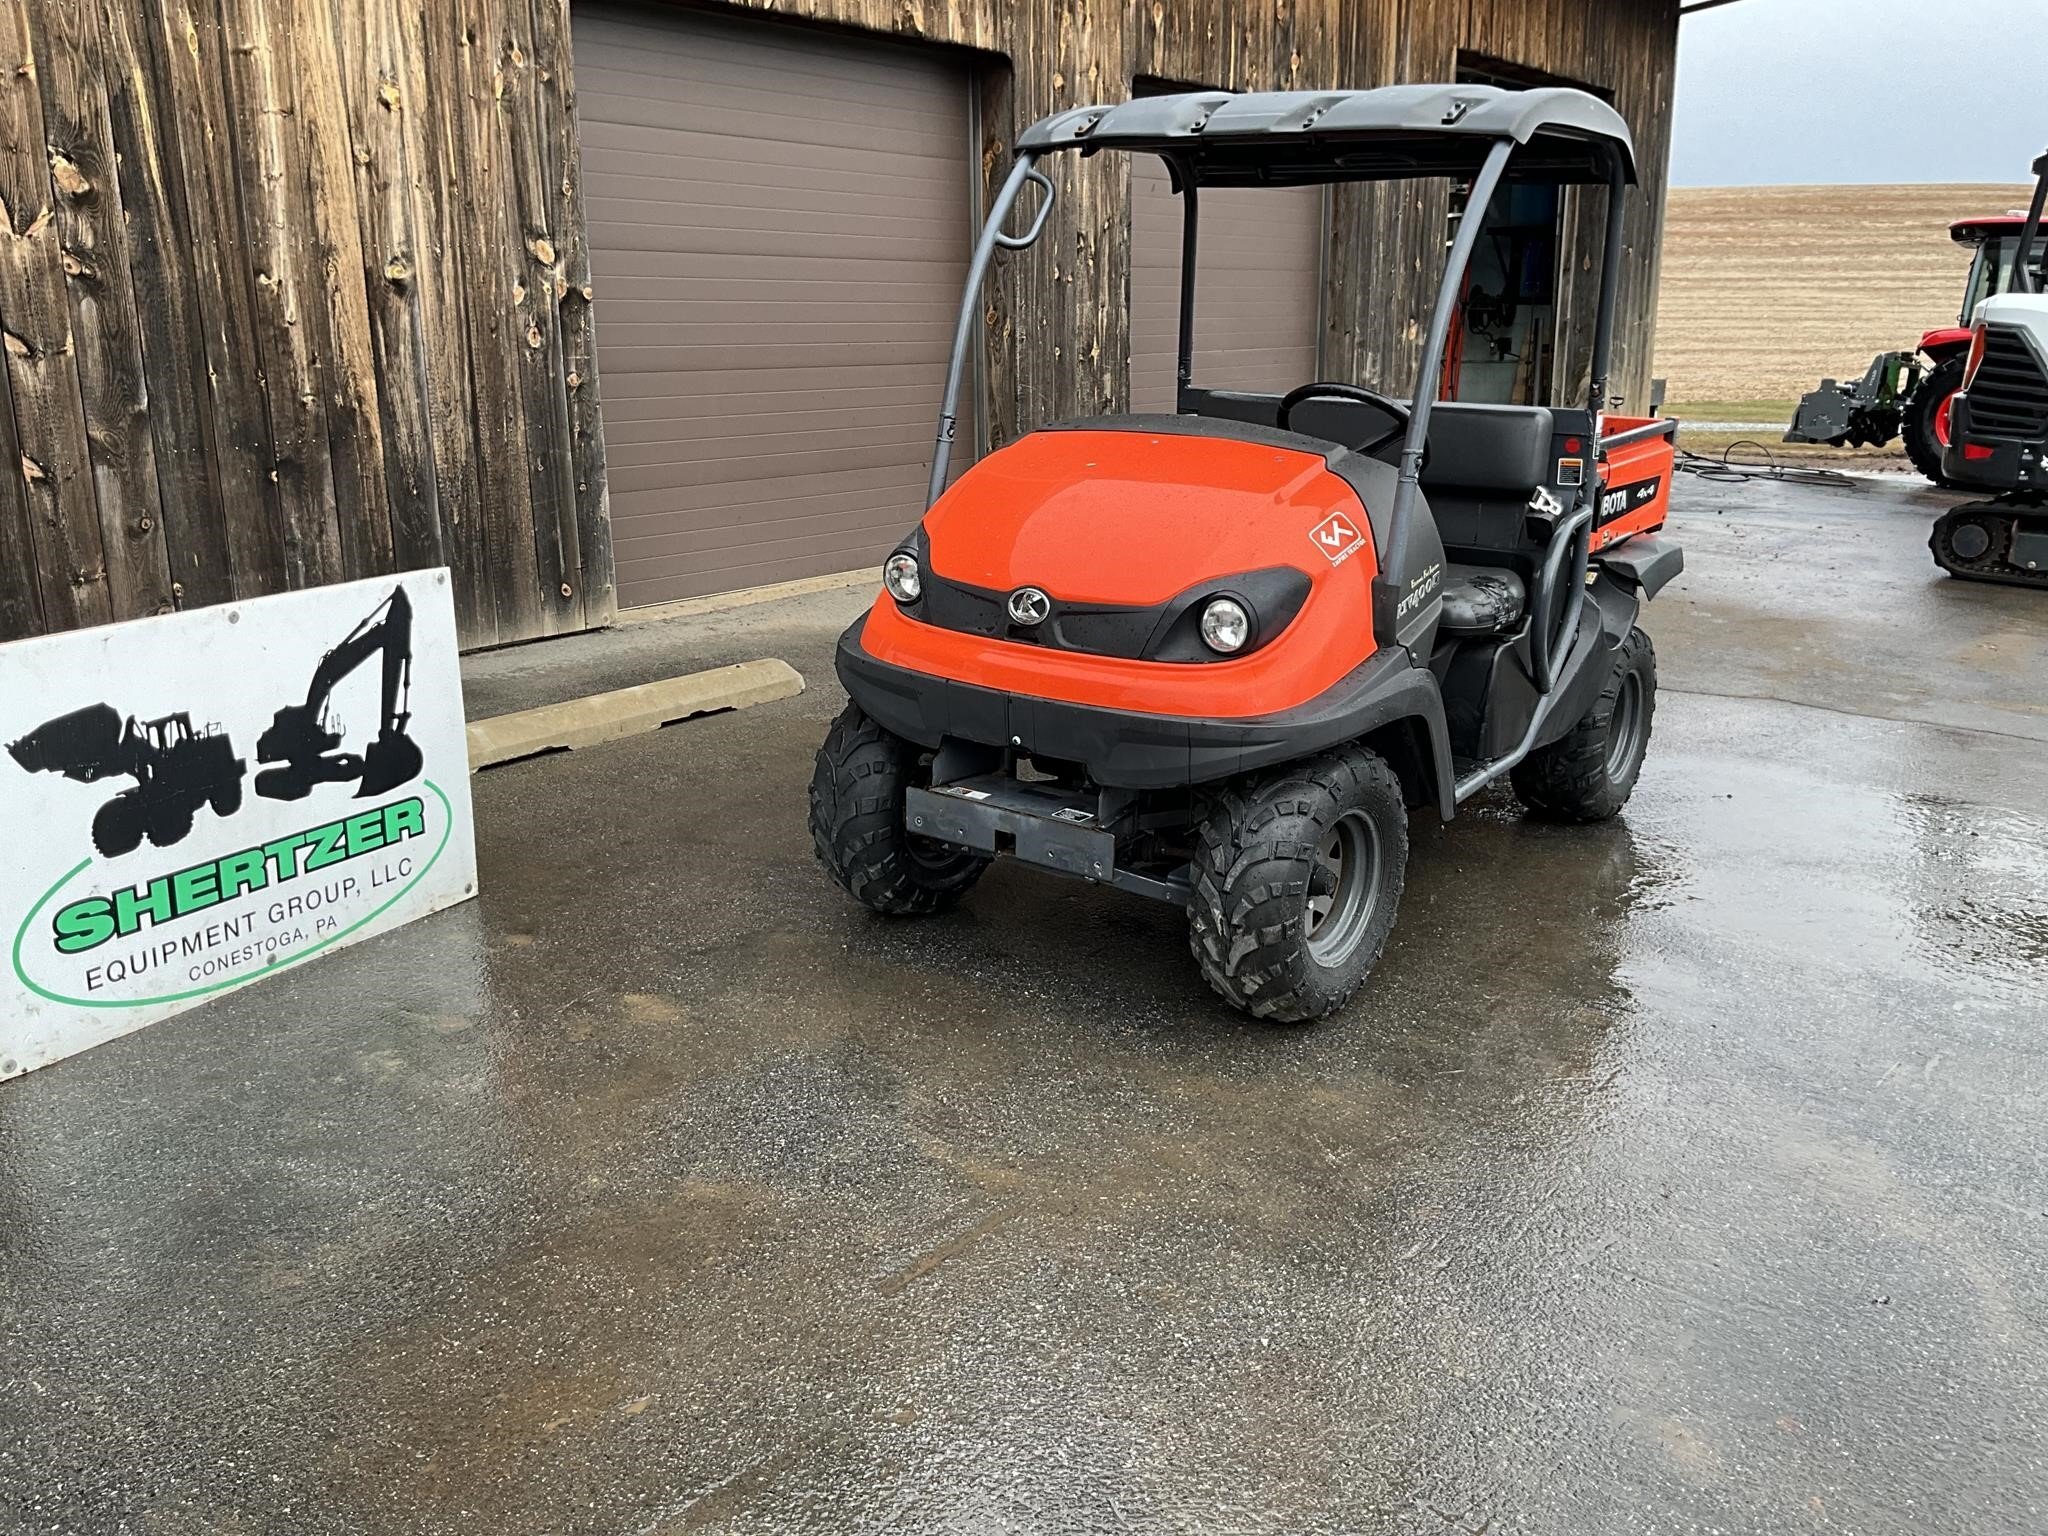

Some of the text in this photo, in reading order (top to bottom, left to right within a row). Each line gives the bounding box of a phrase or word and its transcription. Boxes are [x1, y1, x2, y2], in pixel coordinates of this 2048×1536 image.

[1601, 484, 1655, 516] BOTA 4x4
[53, 796, 426, 955] SHERTZER
[86, 857, 413, 991] EQUIPMENT GROUP, LLC
[189, 915, 337, 982] CONESTOGA, PA
